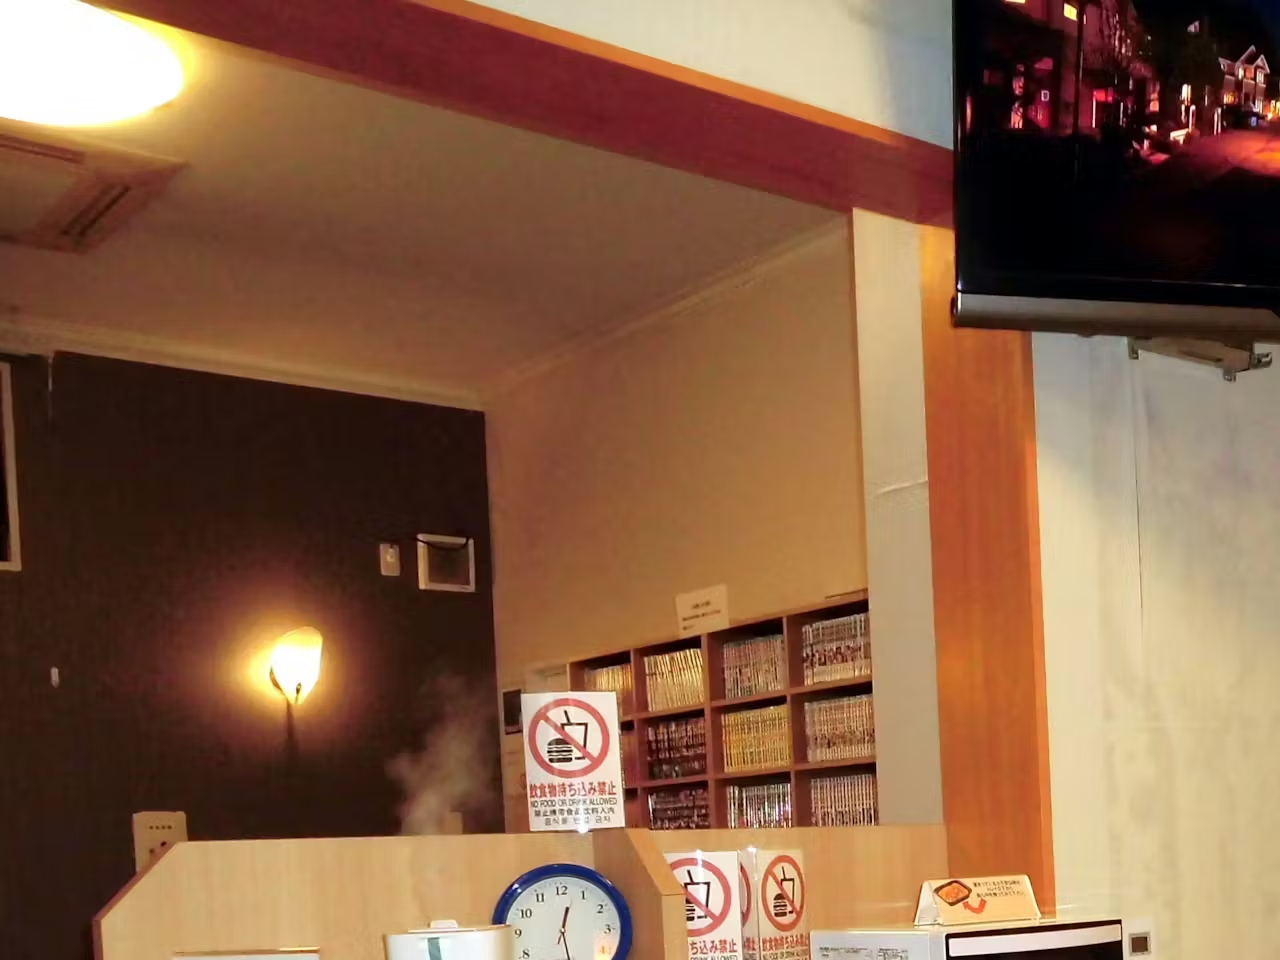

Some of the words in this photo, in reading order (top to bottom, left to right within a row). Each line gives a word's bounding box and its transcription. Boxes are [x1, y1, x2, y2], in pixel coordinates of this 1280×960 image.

[529, 781, 616, 798] 飲食物持ち込み禁止
[531, 800, 538, 808] NO
[540, 799, 557, 807] FOOD
[558, 799, 567, 807] OR
[589, 797, 617, 806] ALLOWED
[555, 885, 568, 896] 12
[581, 890, 586, 900] 1
[535, 893, 545, 903] 11
[520, 908, 532, 919] 10
[597, 904, 604, 914] 2
[514, 929, 522, 938] 9
[604, 924, 612, 934] 3
[690, 938, 737, 955] ち込み禁止
[522, 948, 530, 959] 8
